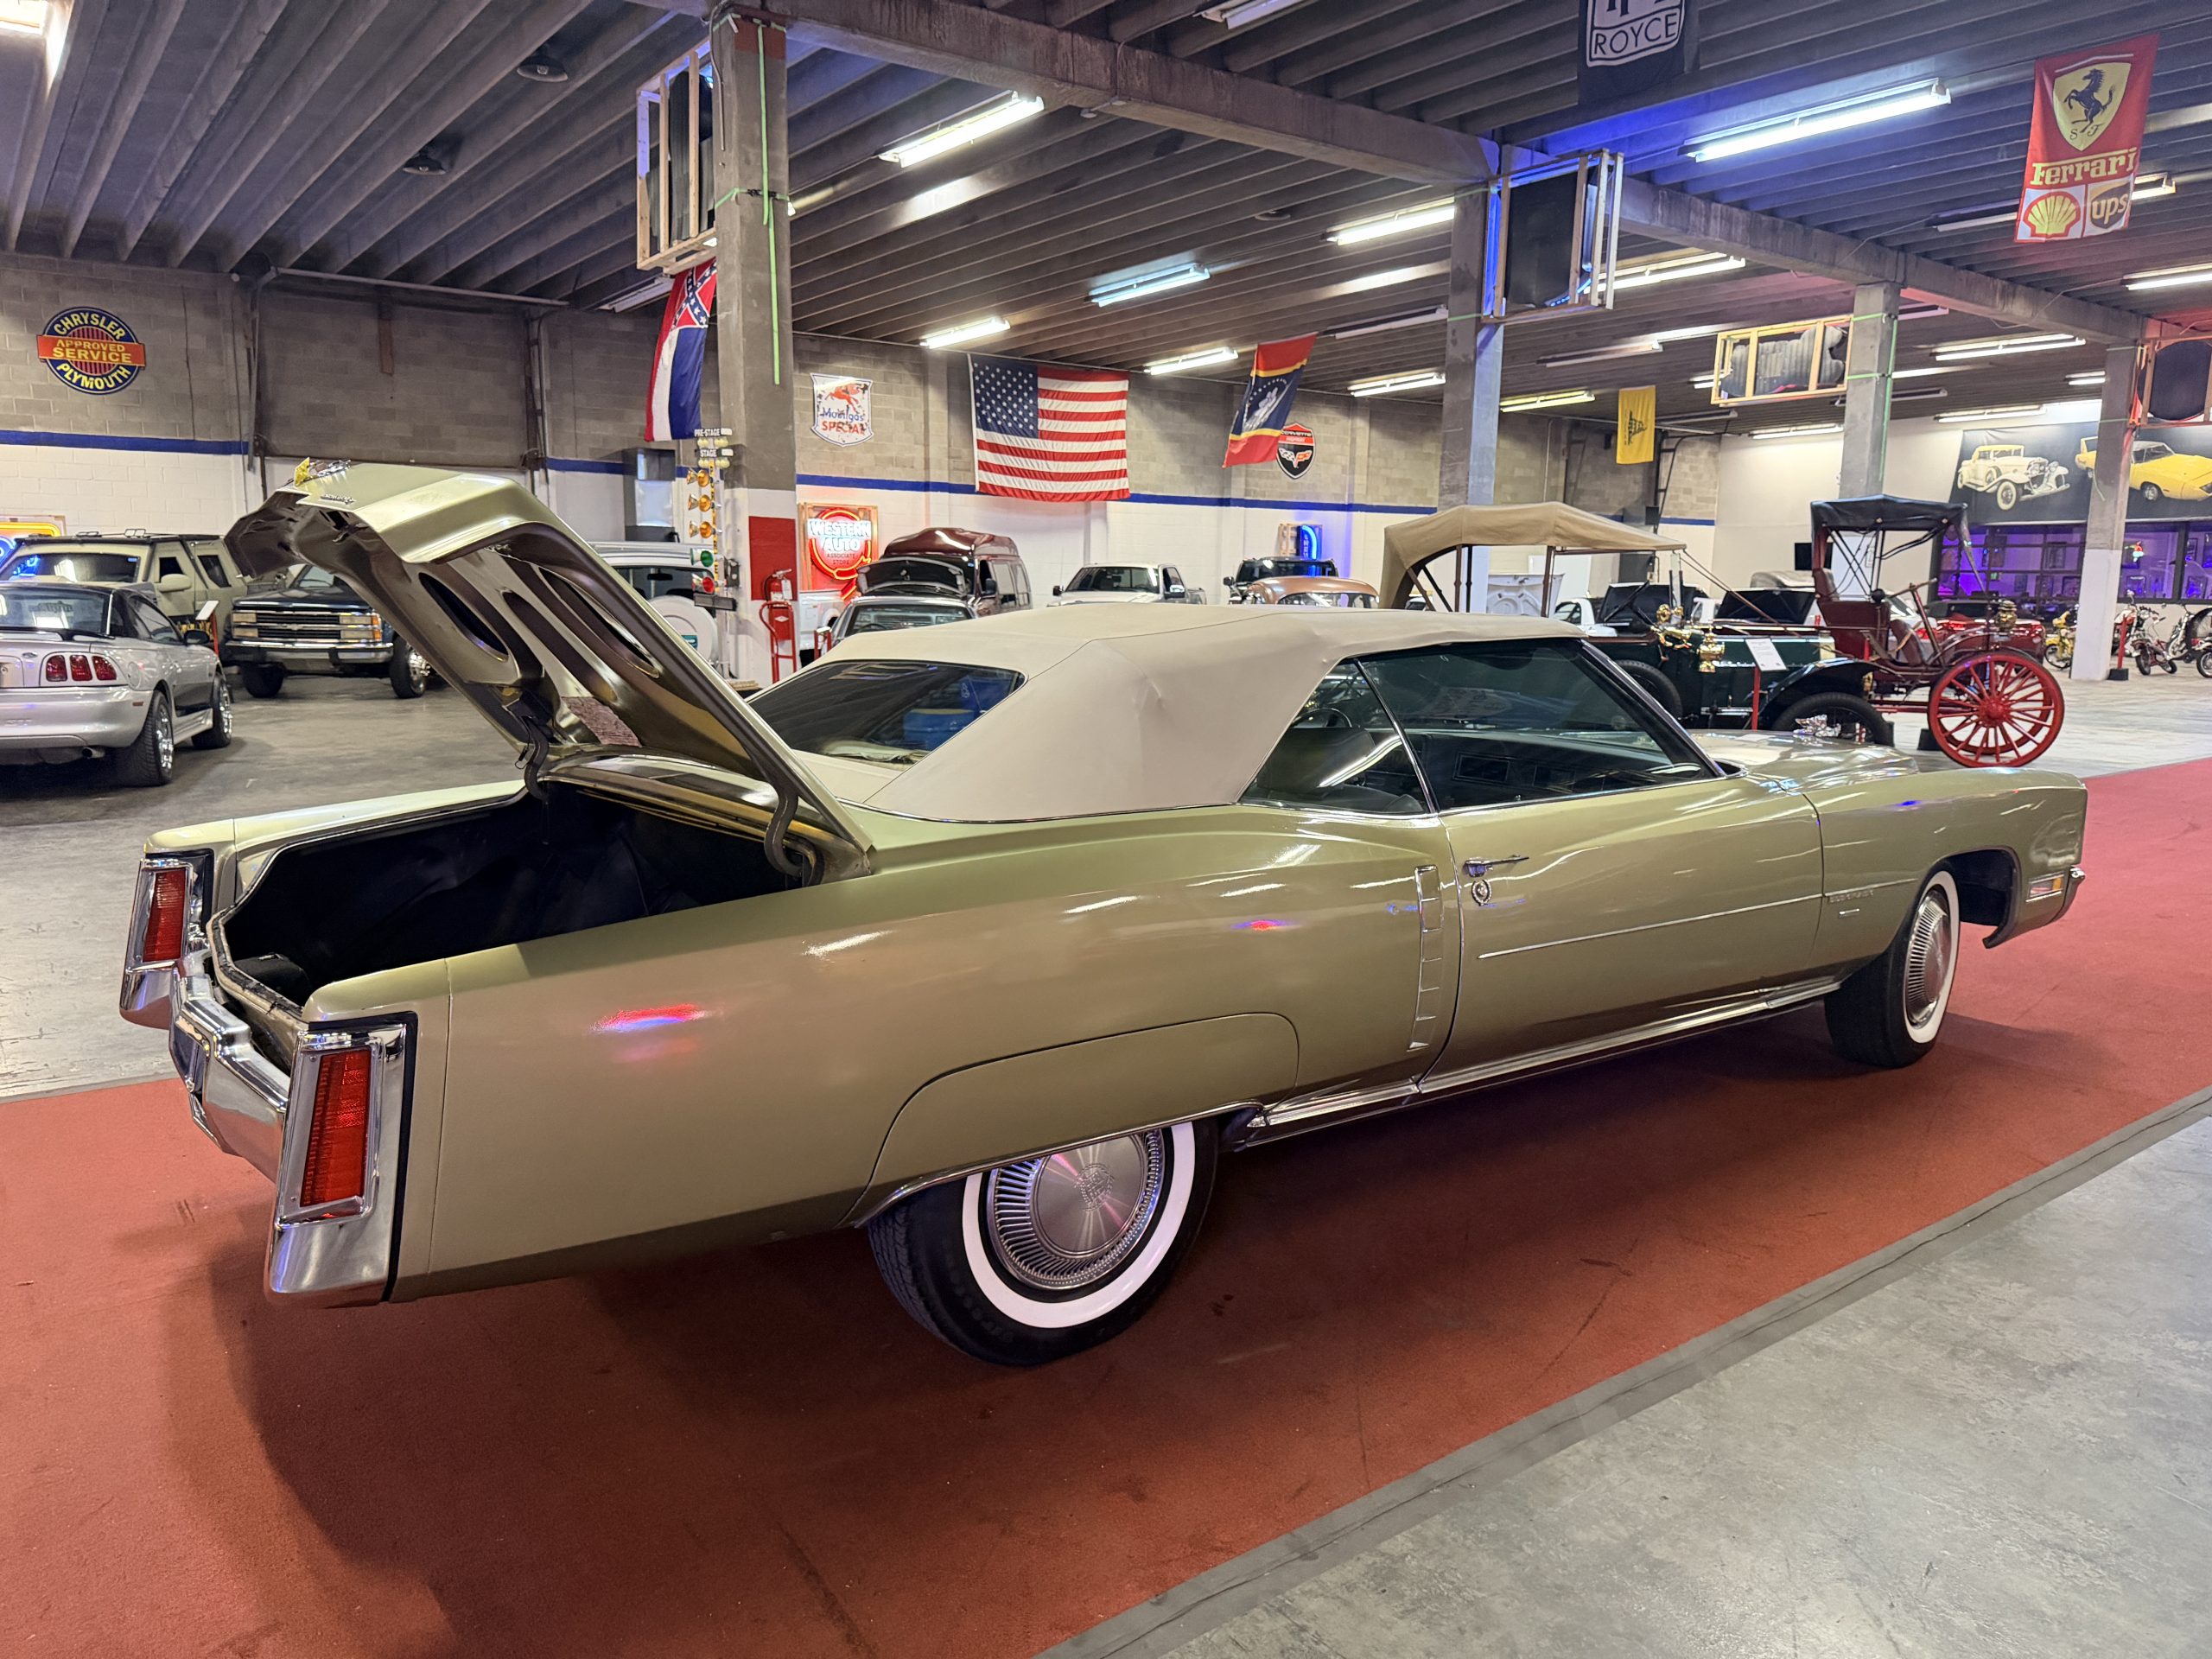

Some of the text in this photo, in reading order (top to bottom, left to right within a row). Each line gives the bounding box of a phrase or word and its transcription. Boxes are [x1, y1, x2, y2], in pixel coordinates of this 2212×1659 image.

[1594, 12, 1677, 55] ROYCE
[2030, 147, 2138, 186] Ferrari
[2092, 193, 2129, 225] ups
[53, 312, 126, 340] CHRYSLER
[52, 346, 132, 363] SERVICE
[56, 340, 125, 353] APPROVED
[56, 363, 131, 390] PLYMOUTH
[694, 428, 721, 437] PRE-STAGE
[700, 448, 717, 457] STAGE
[809, 520, 870, 537] WESTERN
[823, 537, 861, 552] AUTO
